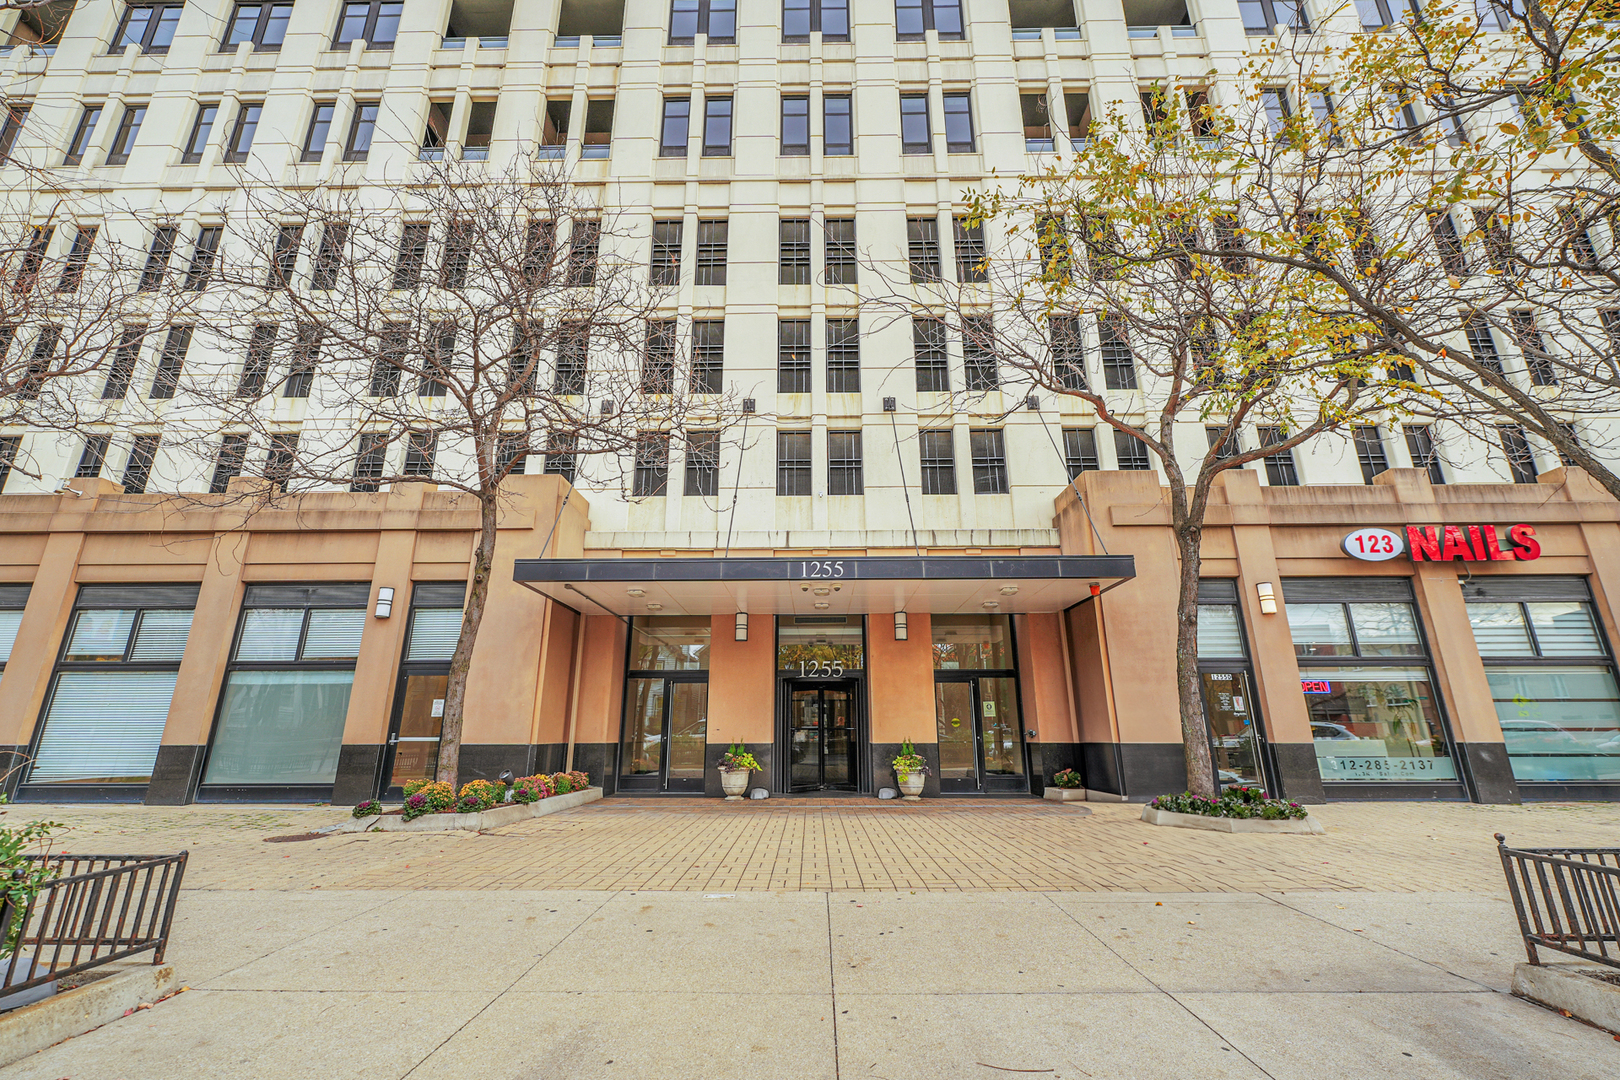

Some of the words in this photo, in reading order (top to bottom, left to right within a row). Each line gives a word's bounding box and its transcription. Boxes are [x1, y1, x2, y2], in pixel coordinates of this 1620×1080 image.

[1355, 534, 1394, 554] 123
[1404, 523, 1541, 562] NAILS
[801, 561, 844, 578] 1255
[799, 660, 843, 678] 1255
[1330, 760, 1434, 771] 312-285-2137
